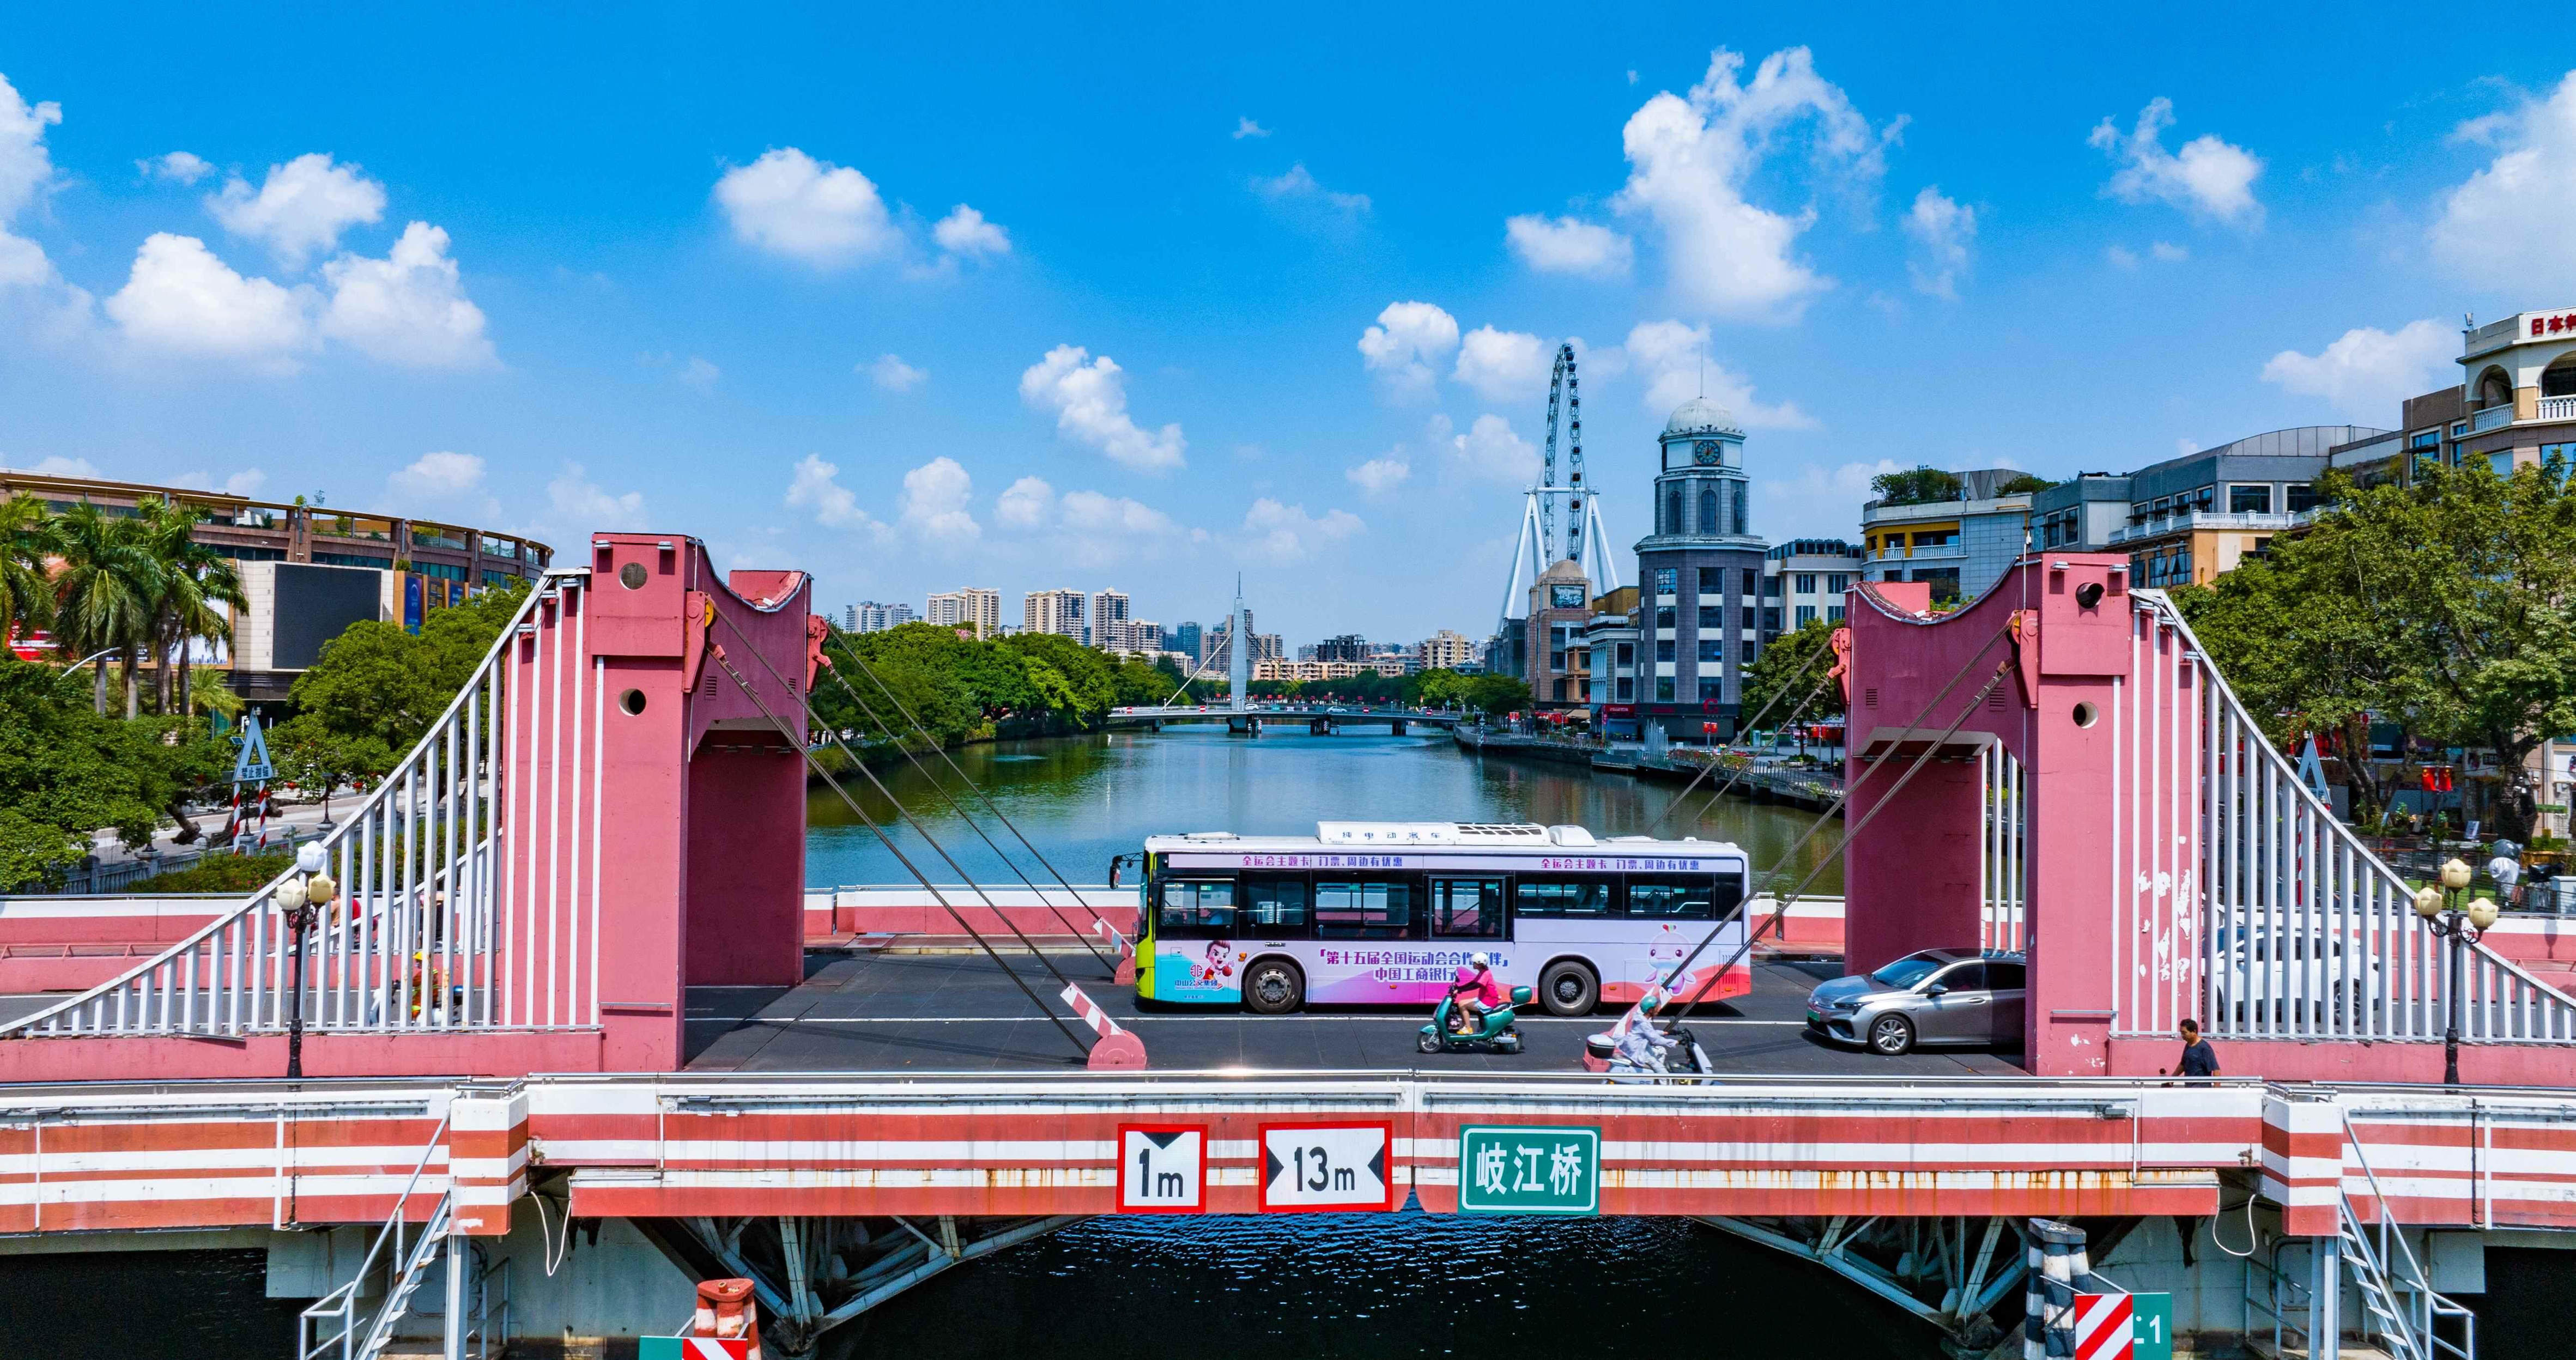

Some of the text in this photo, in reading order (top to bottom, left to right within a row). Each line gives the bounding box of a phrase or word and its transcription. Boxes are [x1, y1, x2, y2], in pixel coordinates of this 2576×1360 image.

[1242, 855, 1403, 867] 全运会主题卡 门票、周边有优惠
[1541, 858, 1699, 870] 全运会主题卡 门票、周边有优惠
[1320, 949, 1508, 967] 「第十五届全国运动会合作伴」
[1375, 967, 1455, 981] 中国工商银行
[1139, 1149, 1183, 1197] 1m
[1294, 1146, 1355, 1192] 13m
[1476, 1142, 1582, 1195] 岐江桥
